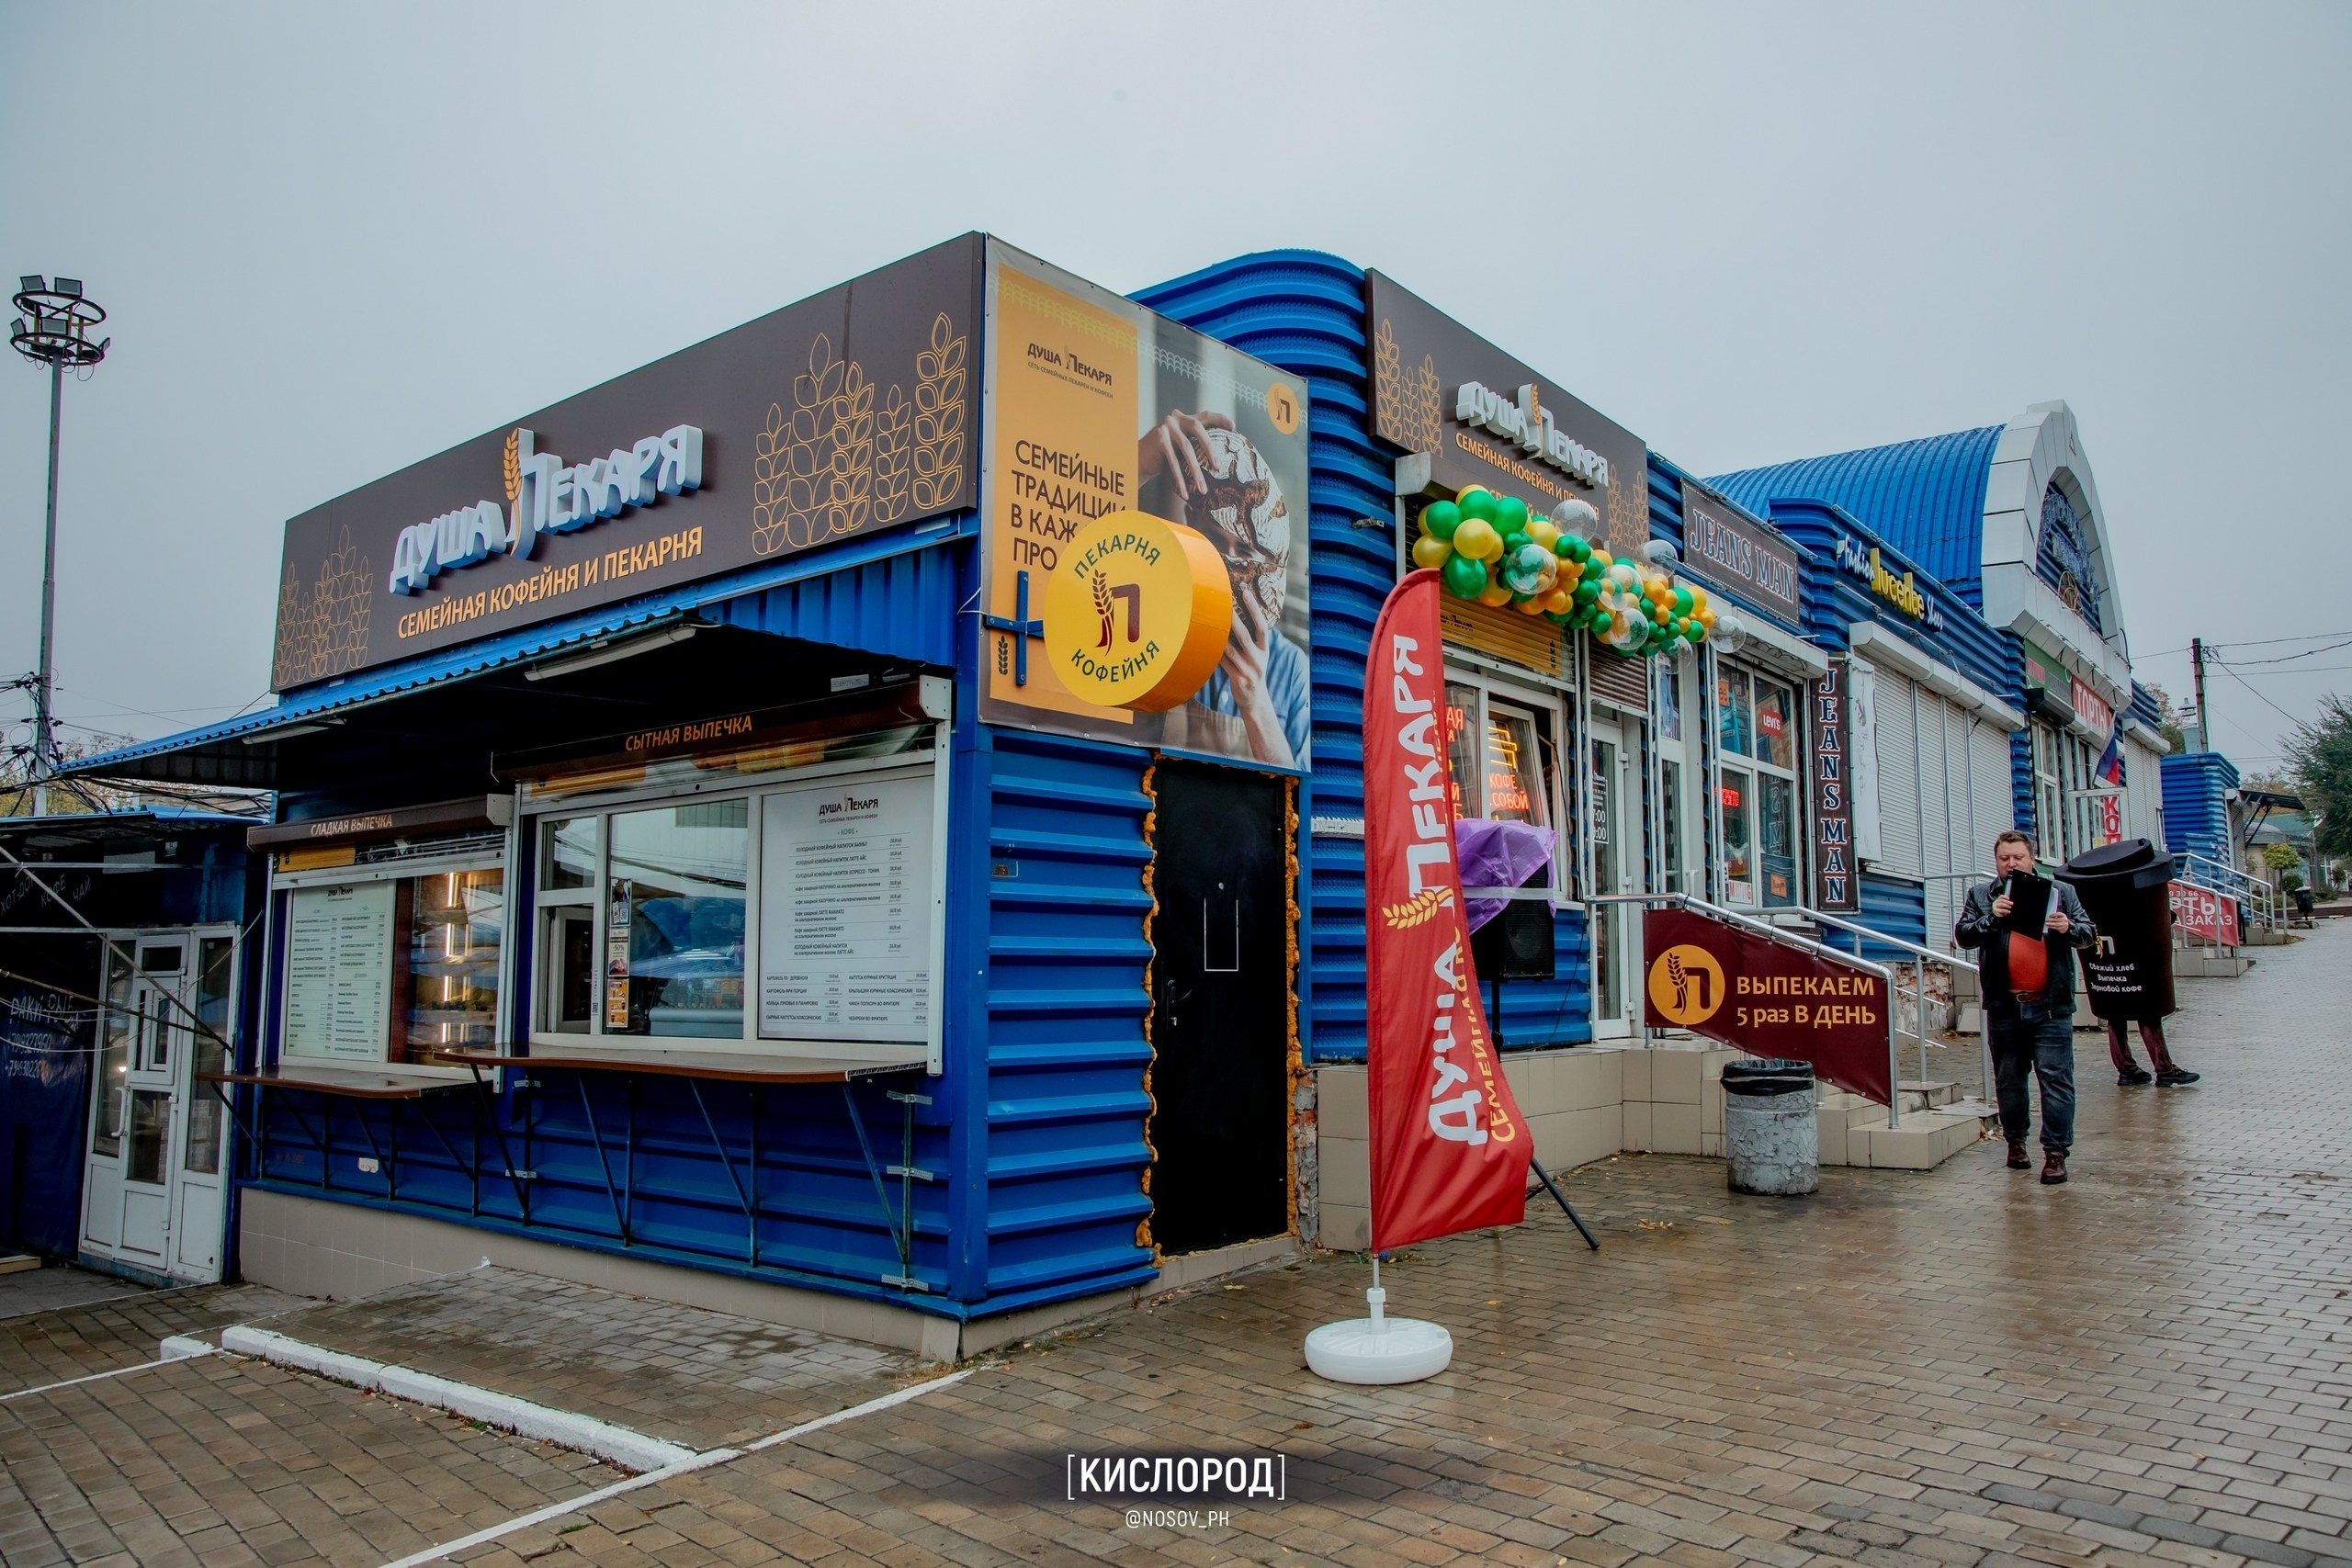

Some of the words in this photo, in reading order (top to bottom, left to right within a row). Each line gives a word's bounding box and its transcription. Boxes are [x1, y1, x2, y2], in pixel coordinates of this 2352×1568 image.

[1027, 343, 1062, 366] ДУША
[1066, 353, 1113, 386] ПЕКАРЯ
[1456, 380, 1530, 445] ДУША
[1518, 383, 1608, 489] ПЕКАРЯ
[1015, 440, 1125, 497] СЕМЕЙНЫЕ
[1454, 432, 1510, 473] СЕМЕЙНАЯ
[1511, 459, 1555, 496] КОФЕЙНЯ
[1555, 484, 1563, 501] И
[390, 500, 507, 595] ДУША
[504, 424, 704, 560] ПЕКАРЯ
[1011, 469, 1126, 522] ТРАДИЦИ
[1011, 502, 1023, 529] В
[1073, 534, 1161, 580] ПЕКАРНЯ
[1690, 508, 1753, 581] JEANS
[1755, 546, 1793, 604] MAN
[397, 590, 487, 639] СЕМЕЙНАЯ
[490, 563, 580, 615] КОФЕЙНЯ
[583, 558, 599, 588] И
[603, 525, 704, 581] ПЕКАРНЯ
[1070, 639, 1160, 683] КОФЕЙНЯ
[625, 727, 681, 751] СЫТНАЯ
[683, 715, 753, 742] ВЫПЕЧКА
[1819, 668, 1841, 810] JEANS
[1488, 773, 1518, 790] КОФЕ
[311, 818, 350, 837] СЛАДКАЯ
[350, 814, 393, 834] ВЫПЕЧКА
[819, 803, 842, 816] ДУША
[844, 796, 879, 813] ПЕКАРЯ
[1820, 818, 1847, 903] MAN
[73, 874, 92, 903] ЧАЙ
[2185, 915, 2233, 926] ЗАКАЗ
[1736, 976, 1874, 996] ВЫПЕКАЕМ
[2088, 962, 2114, 972] Свежий
[2116, 963, 2135, 972] хлеб
[2098, 974, 2128, 982] Выпечка
[2090, 982, 2120, 992] Зерновой
[2121, 985, 2143, 993] кофе
[1737, 1008, 1747, 1027] 5
[1753, 1008, 1790, 1028] раз
[1795, 1005, 1809, 1024] В
[1814, 1005, 1876, 1029] ДЕНЬ
